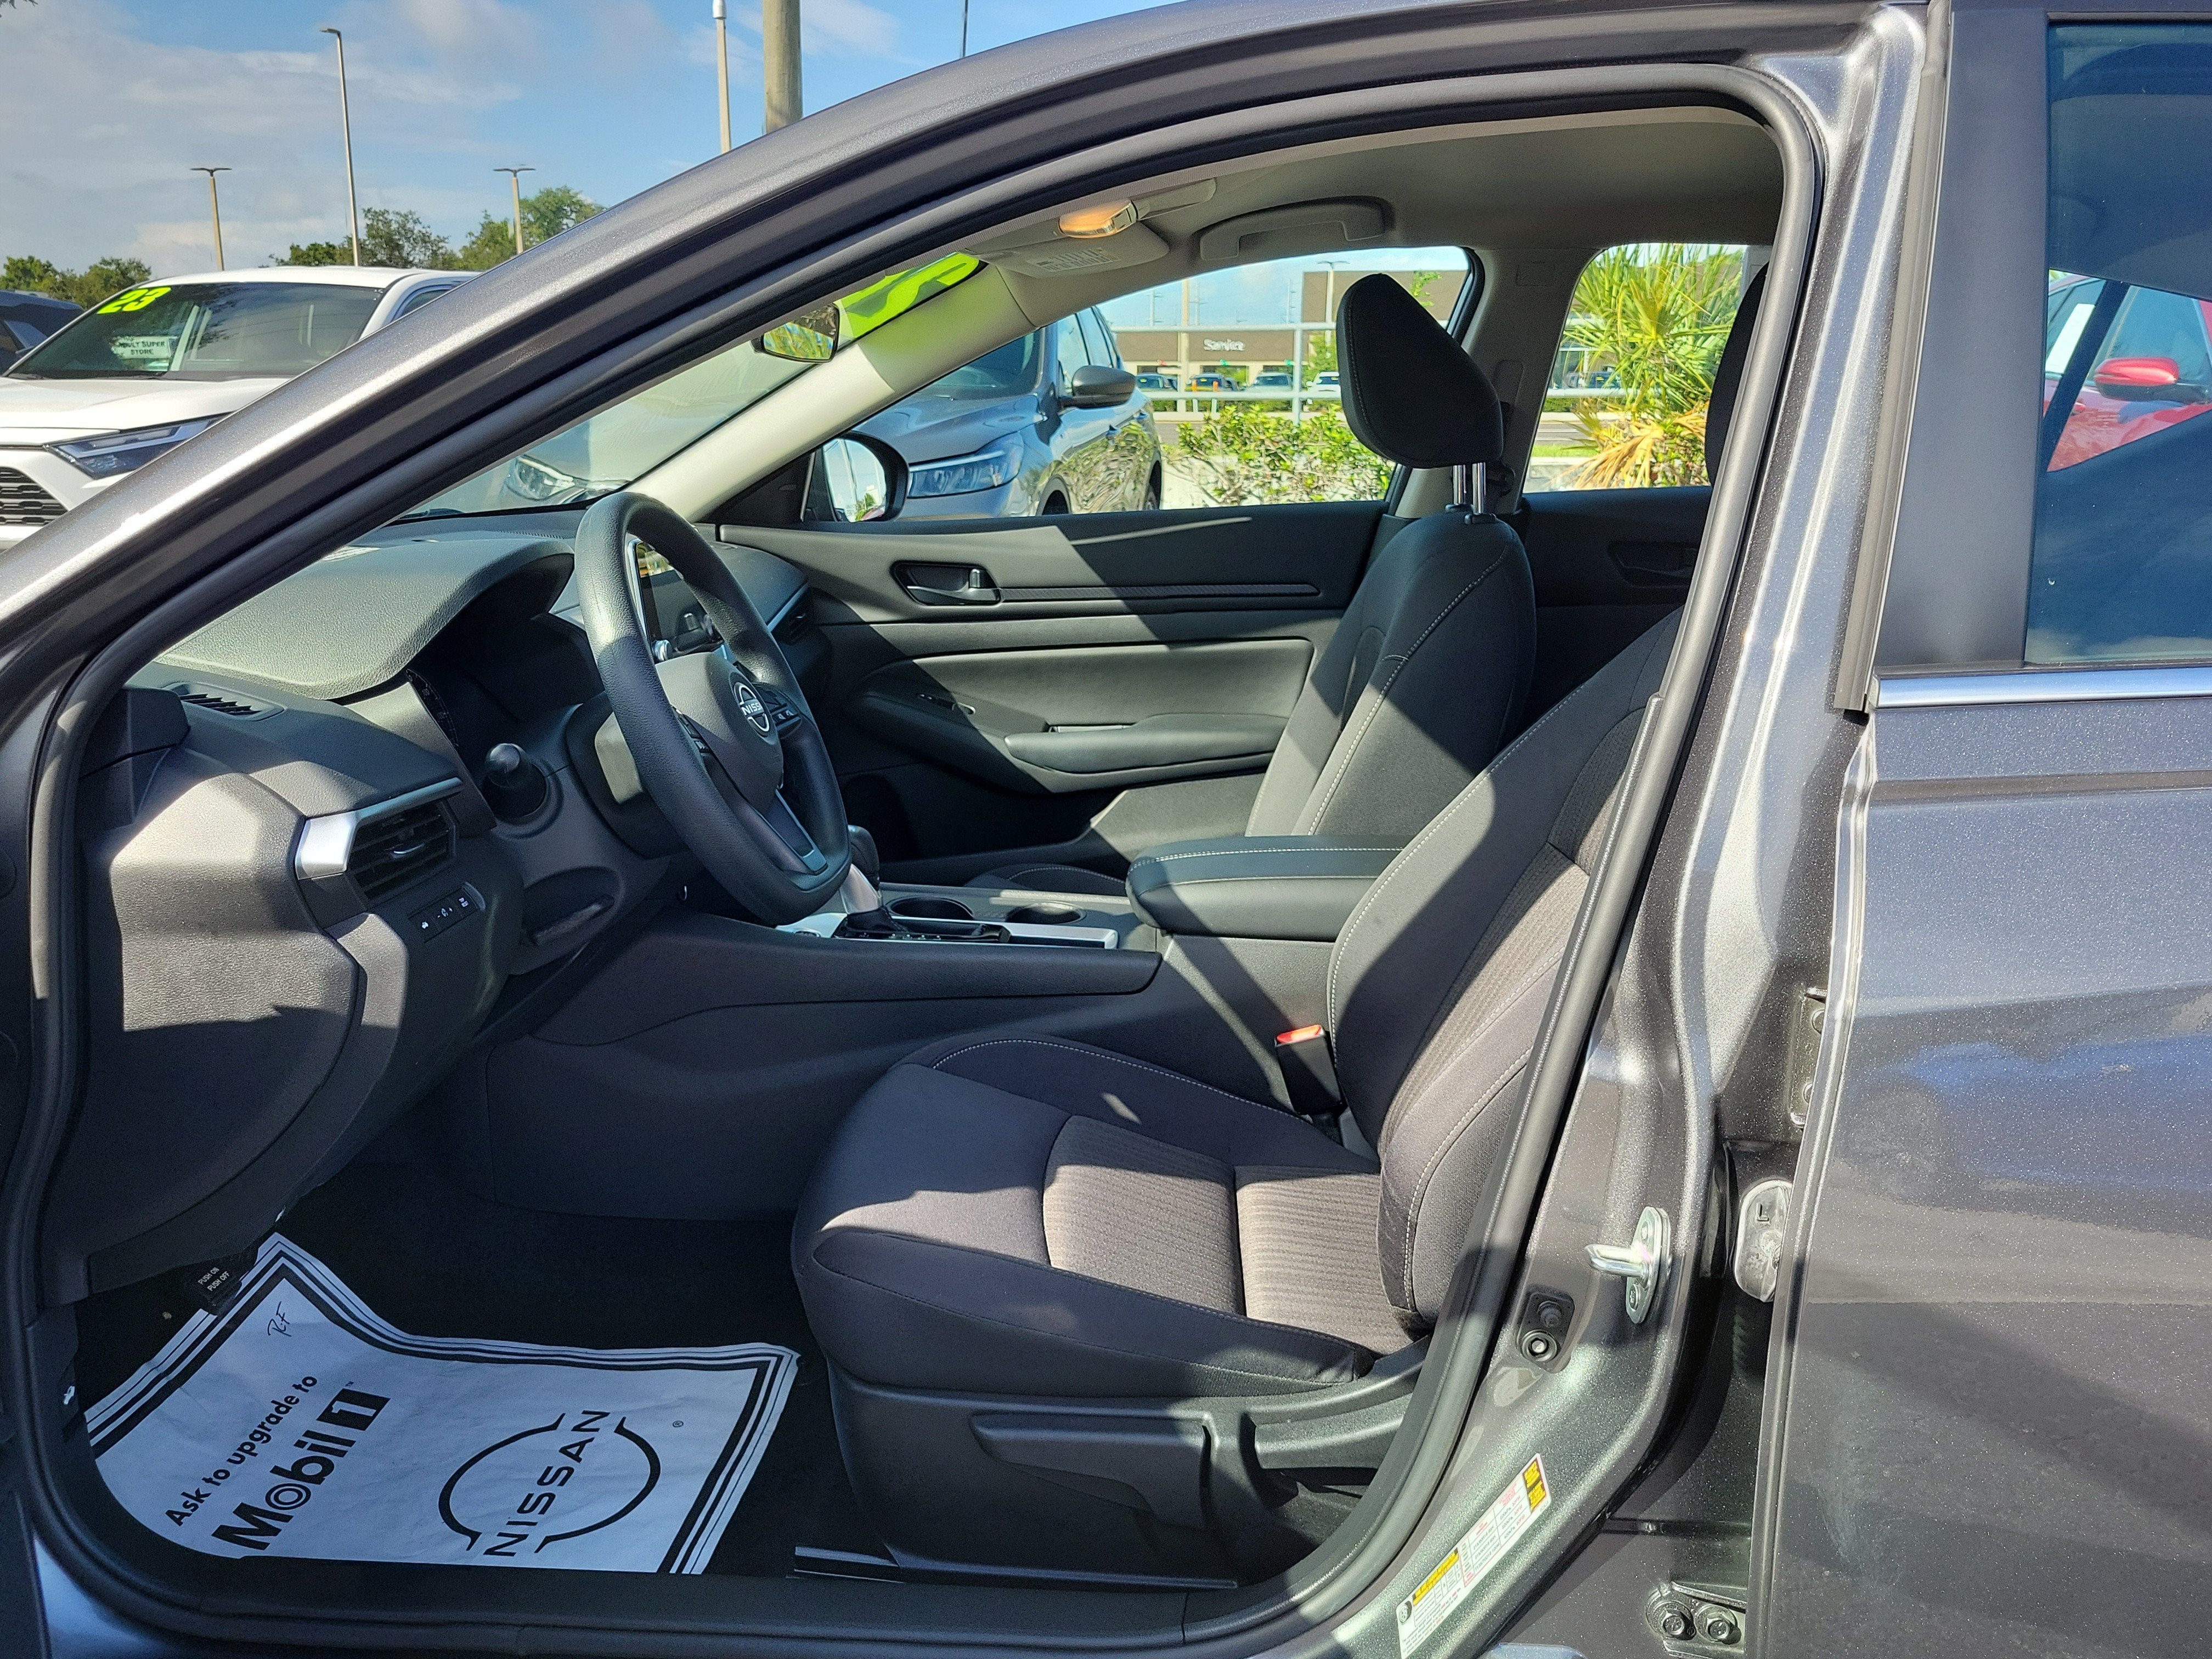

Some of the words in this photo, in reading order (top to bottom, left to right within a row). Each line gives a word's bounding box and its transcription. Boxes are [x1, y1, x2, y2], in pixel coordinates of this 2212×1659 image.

[97, 287, 171, 314] 23
[1203, 338, 1245, 352] Service
[198, 1272, 213, 1285] PUSH
[207, 1278, 222, 1291] PUSH
[219, 1271, 230, 1281] OFF
[165, 1487, 212, 1526] Ask
[202, 1469, 230, 1486] to
[227, 1395, 300, 1465] upgrade
[292, 1376, 318, 1393] to
[211, 1430, 357, 1550] Mobil
[483, 1409, 611, 1557] NISSAN
